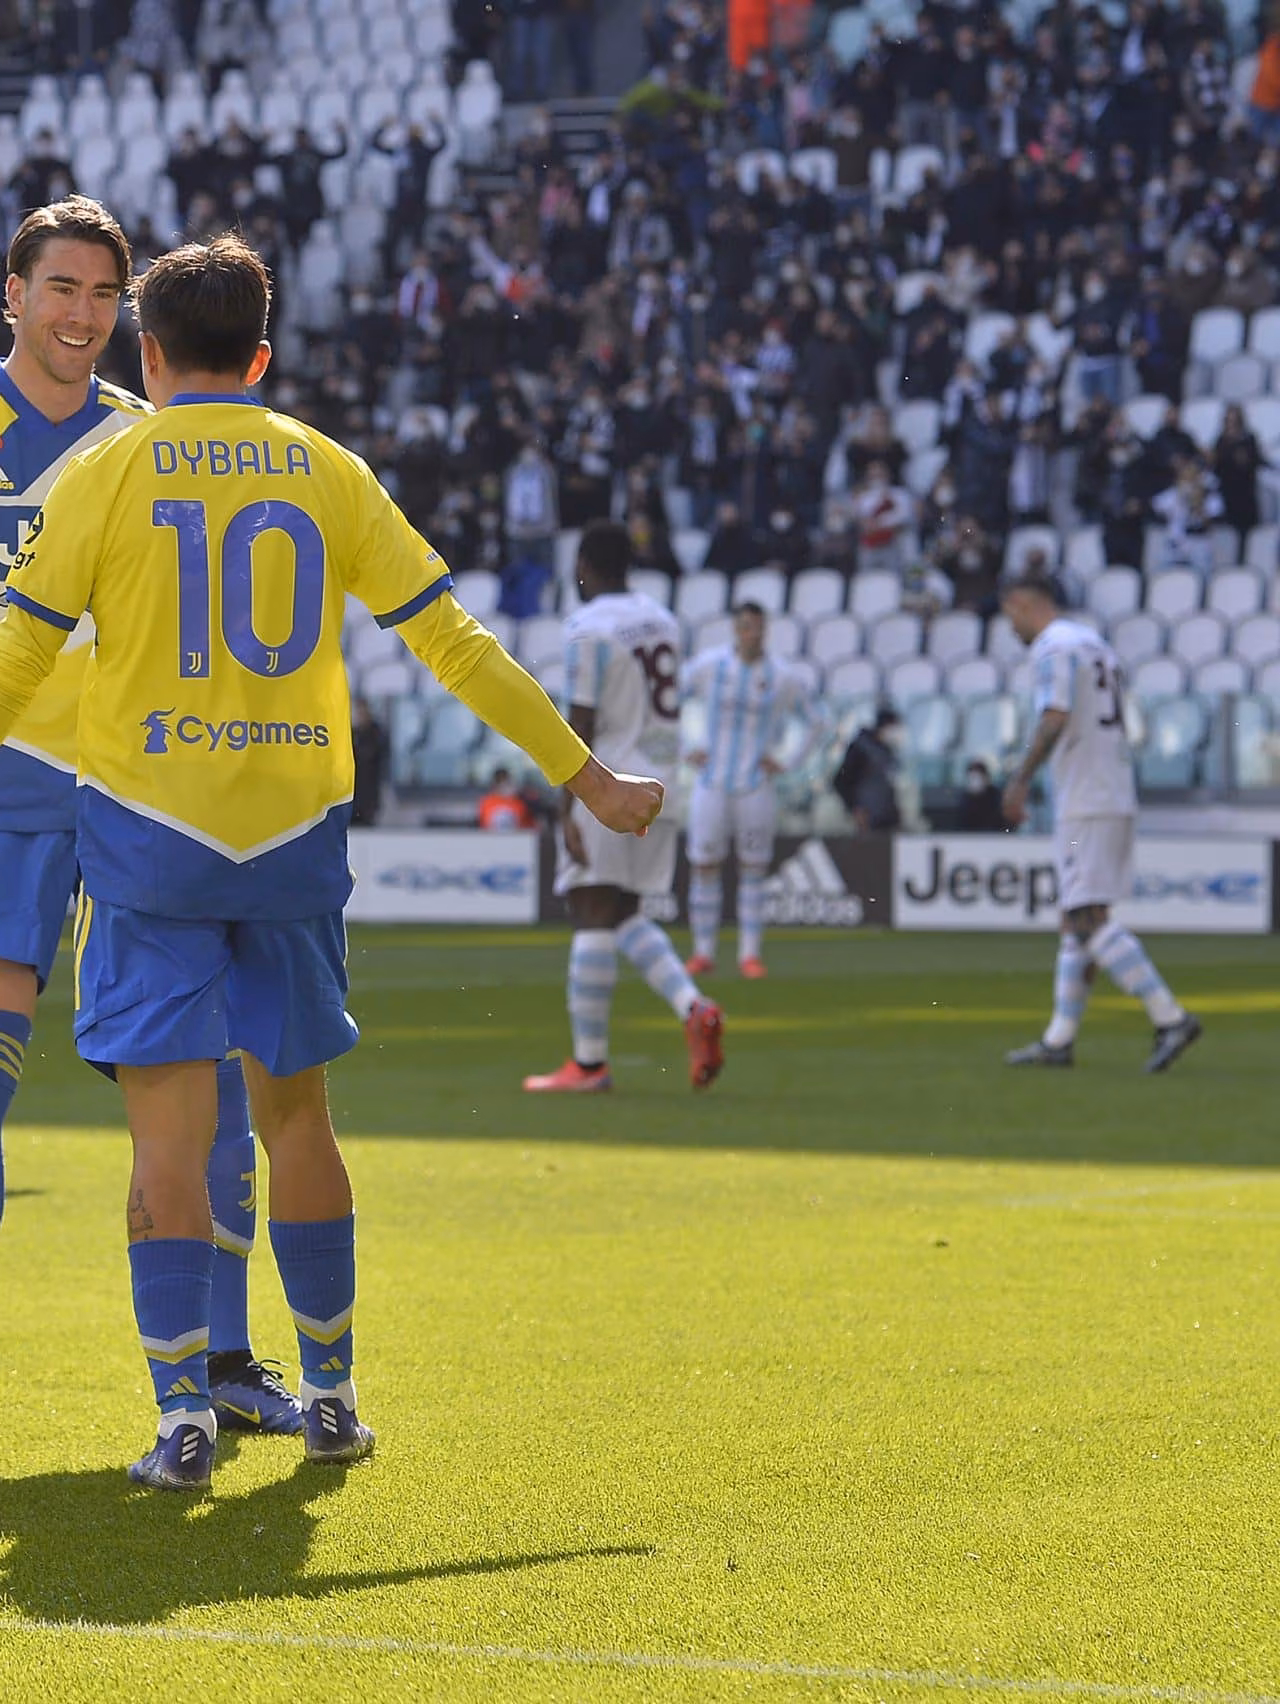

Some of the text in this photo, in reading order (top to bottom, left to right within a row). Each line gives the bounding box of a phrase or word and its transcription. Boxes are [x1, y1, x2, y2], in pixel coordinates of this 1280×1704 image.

[152, 440, 312, 476] DYBALA
[151, 498, 327, 678] 10
[632, 642, 681, 720] 18
[176, 715, 330, 752] Cygames
[903, 846, 1060, 917] Jeep
